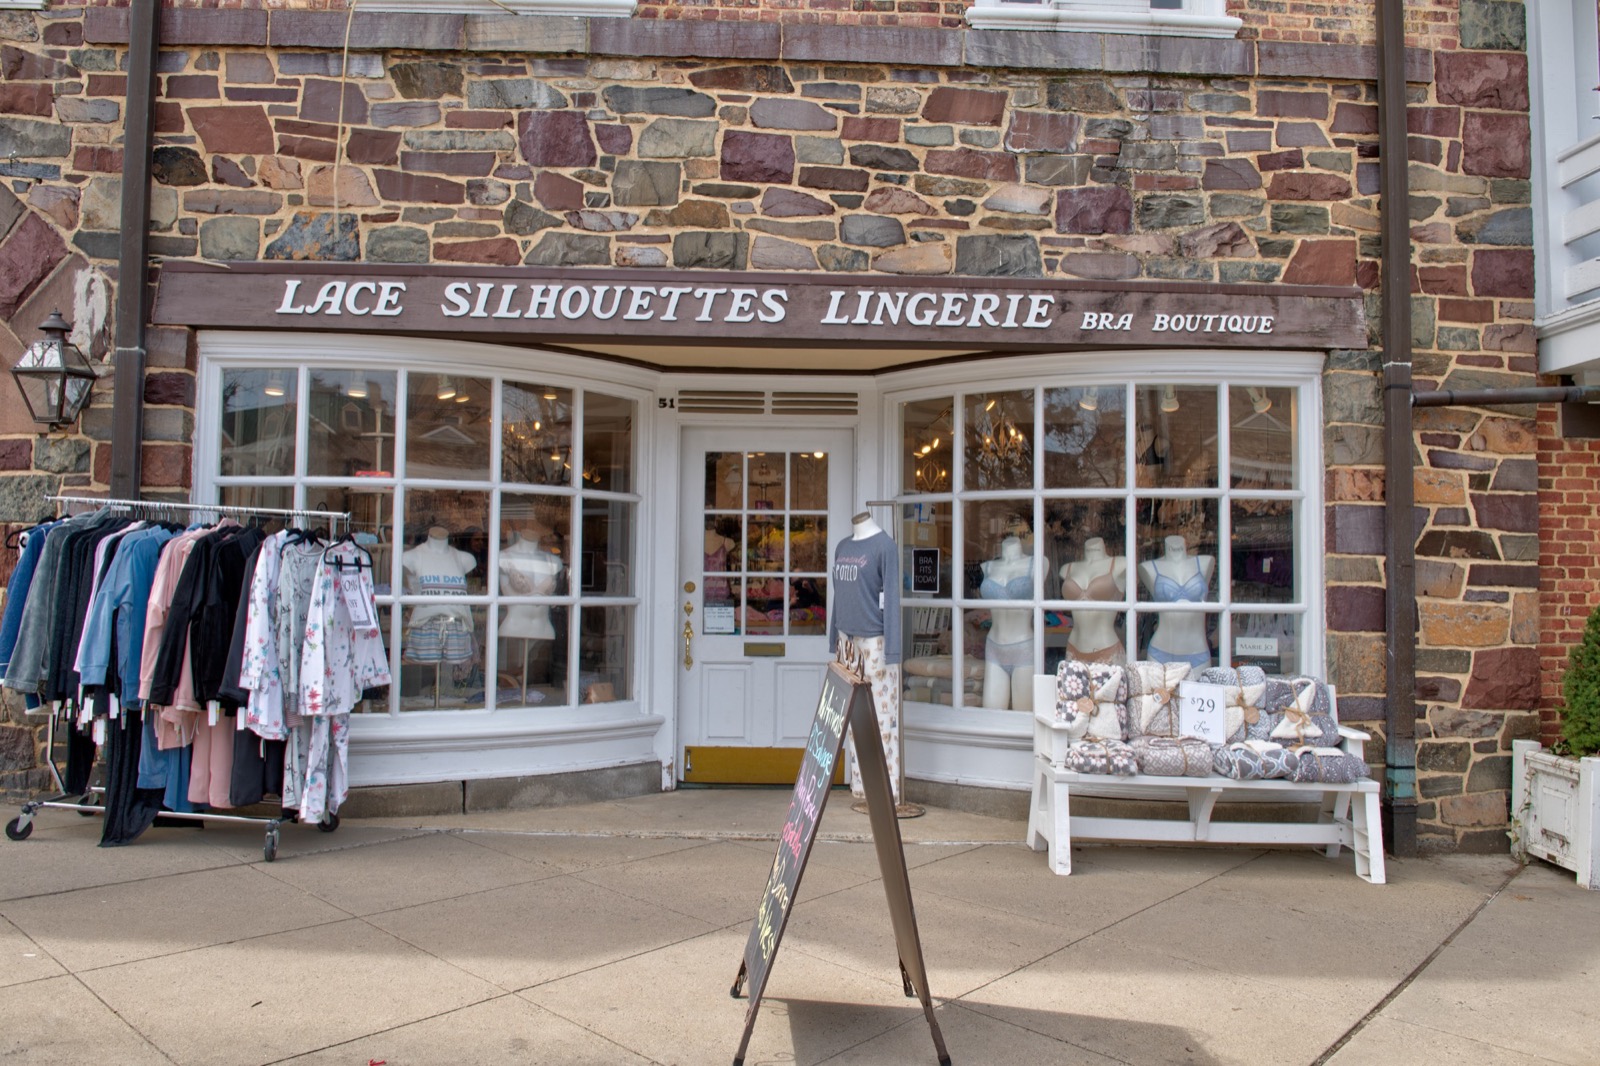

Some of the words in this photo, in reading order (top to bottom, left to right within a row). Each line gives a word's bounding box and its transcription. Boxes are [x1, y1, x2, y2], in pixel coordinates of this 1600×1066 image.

[275, 279, 406, 317] LACE
[441, 281, 789, 323] SILHOUETTES
[821, 289, 1056, 330] LINGERIE
[1080, 311, 1133, 332] BRA
[1152, 313, 1275, 335] BOUTIQUE
[658, 397, 675, 409] 51
[918, 556, 933, 565] BRA
[919, 566, 932, 575] FITS
[914, 575, 937, 584] TODAY
[1191, 697, 1215, 713] $29
